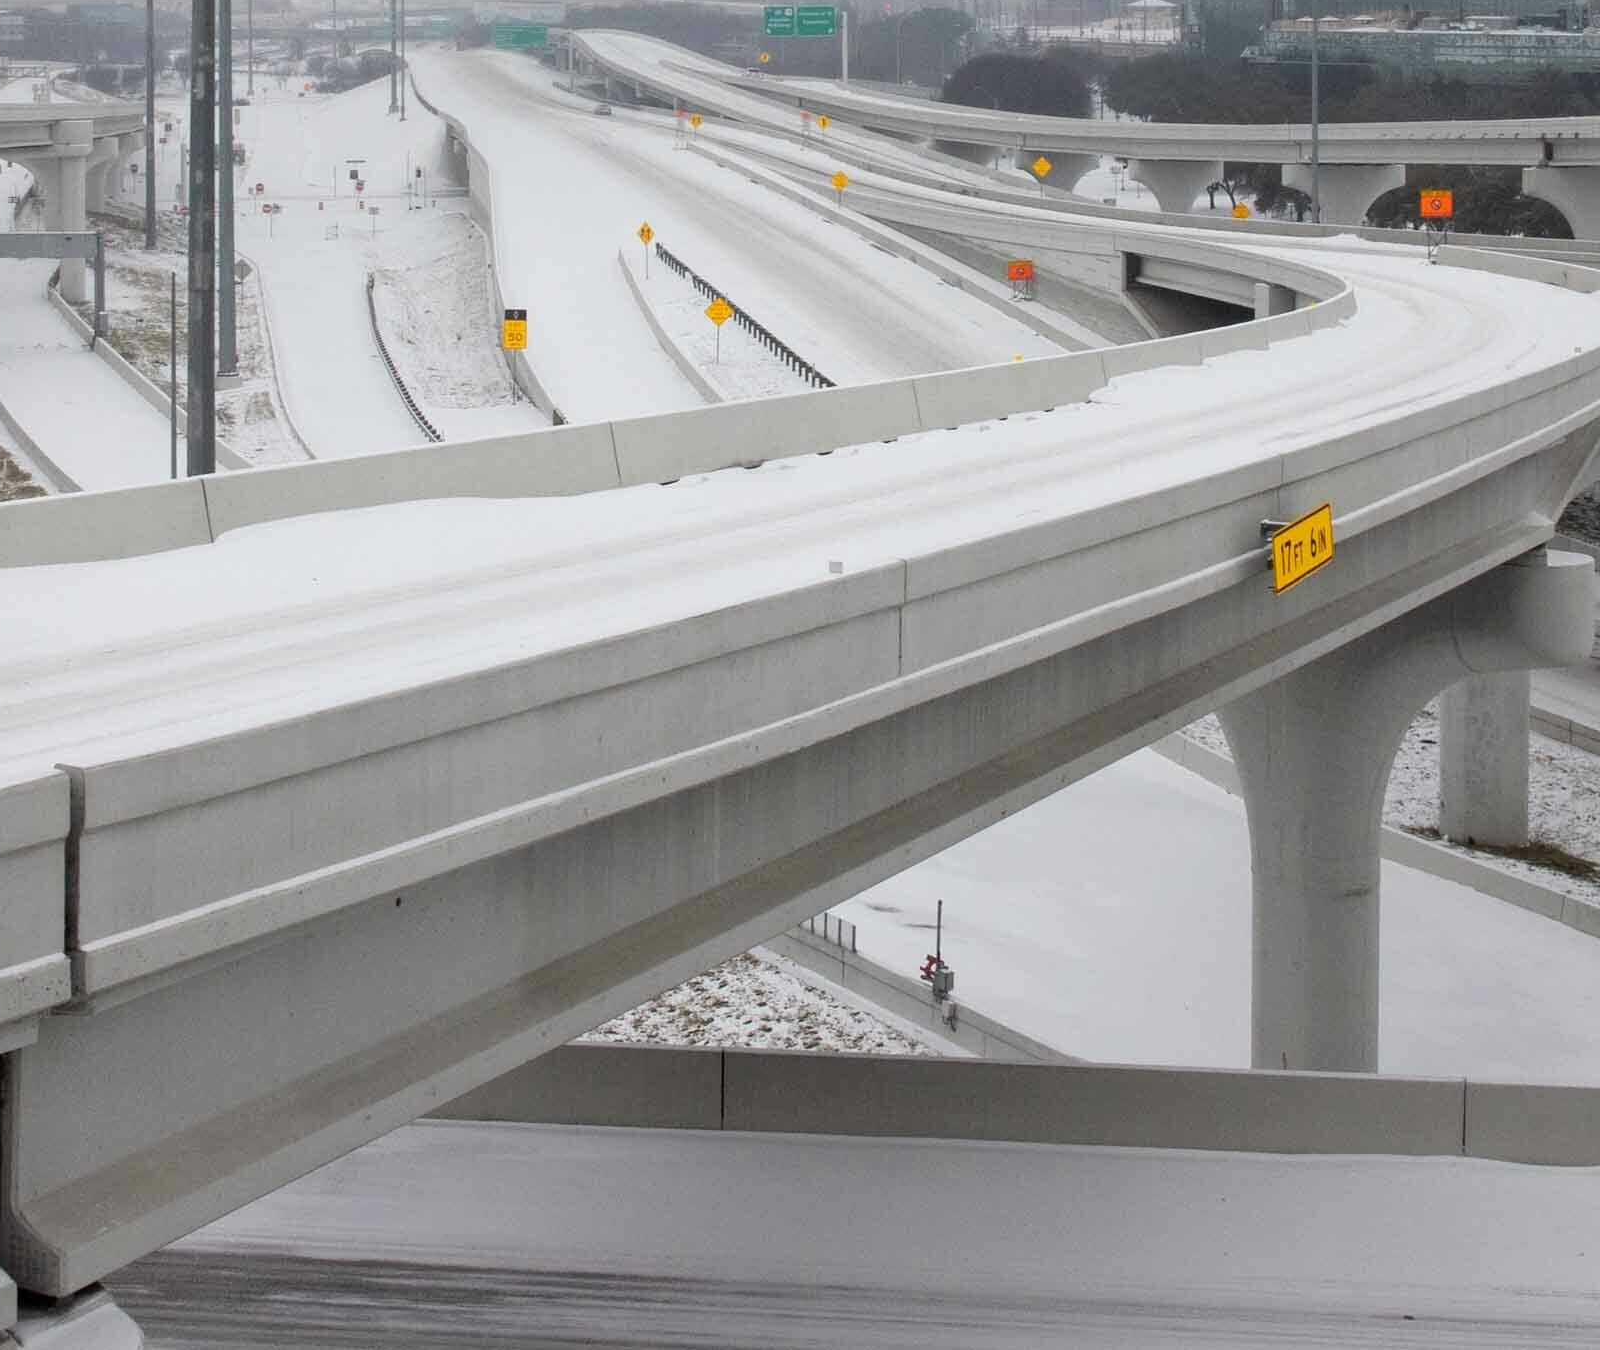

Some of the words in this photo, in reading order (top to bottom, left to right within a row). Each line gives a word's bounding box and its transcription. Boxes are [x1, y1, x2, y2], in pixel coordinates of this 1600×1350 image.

[1281, 539, 1291, 576] 17
[1294, 540, 1303, 569] FT
[1311, 526, 1317, 558] 6
[1319, 526, 1327, 553] IN
